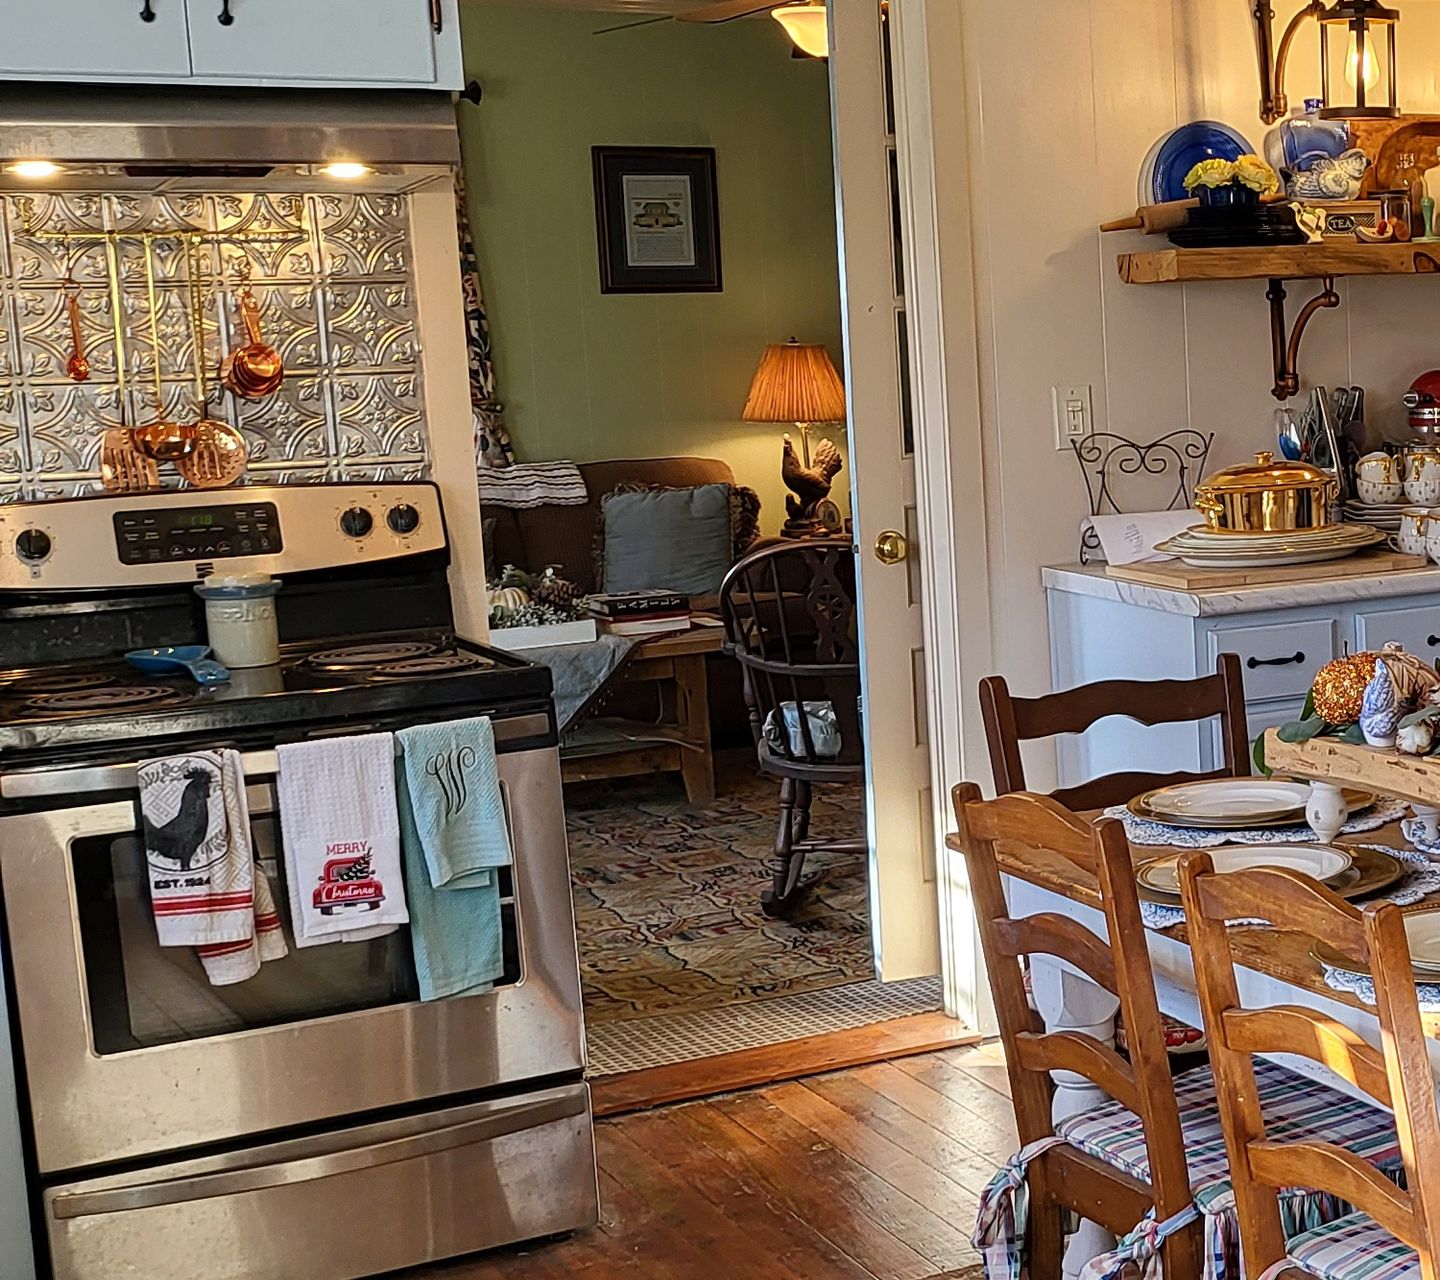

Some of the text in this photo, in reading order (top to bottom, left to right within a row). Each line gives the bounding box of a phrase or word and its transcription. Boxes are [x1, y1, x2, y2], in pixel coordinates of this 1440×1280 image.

[1330, 219, 1352, 228] TEA
[617, 598, 681, 609] FAMILY
[326, 841, 368, 856] MERRY
